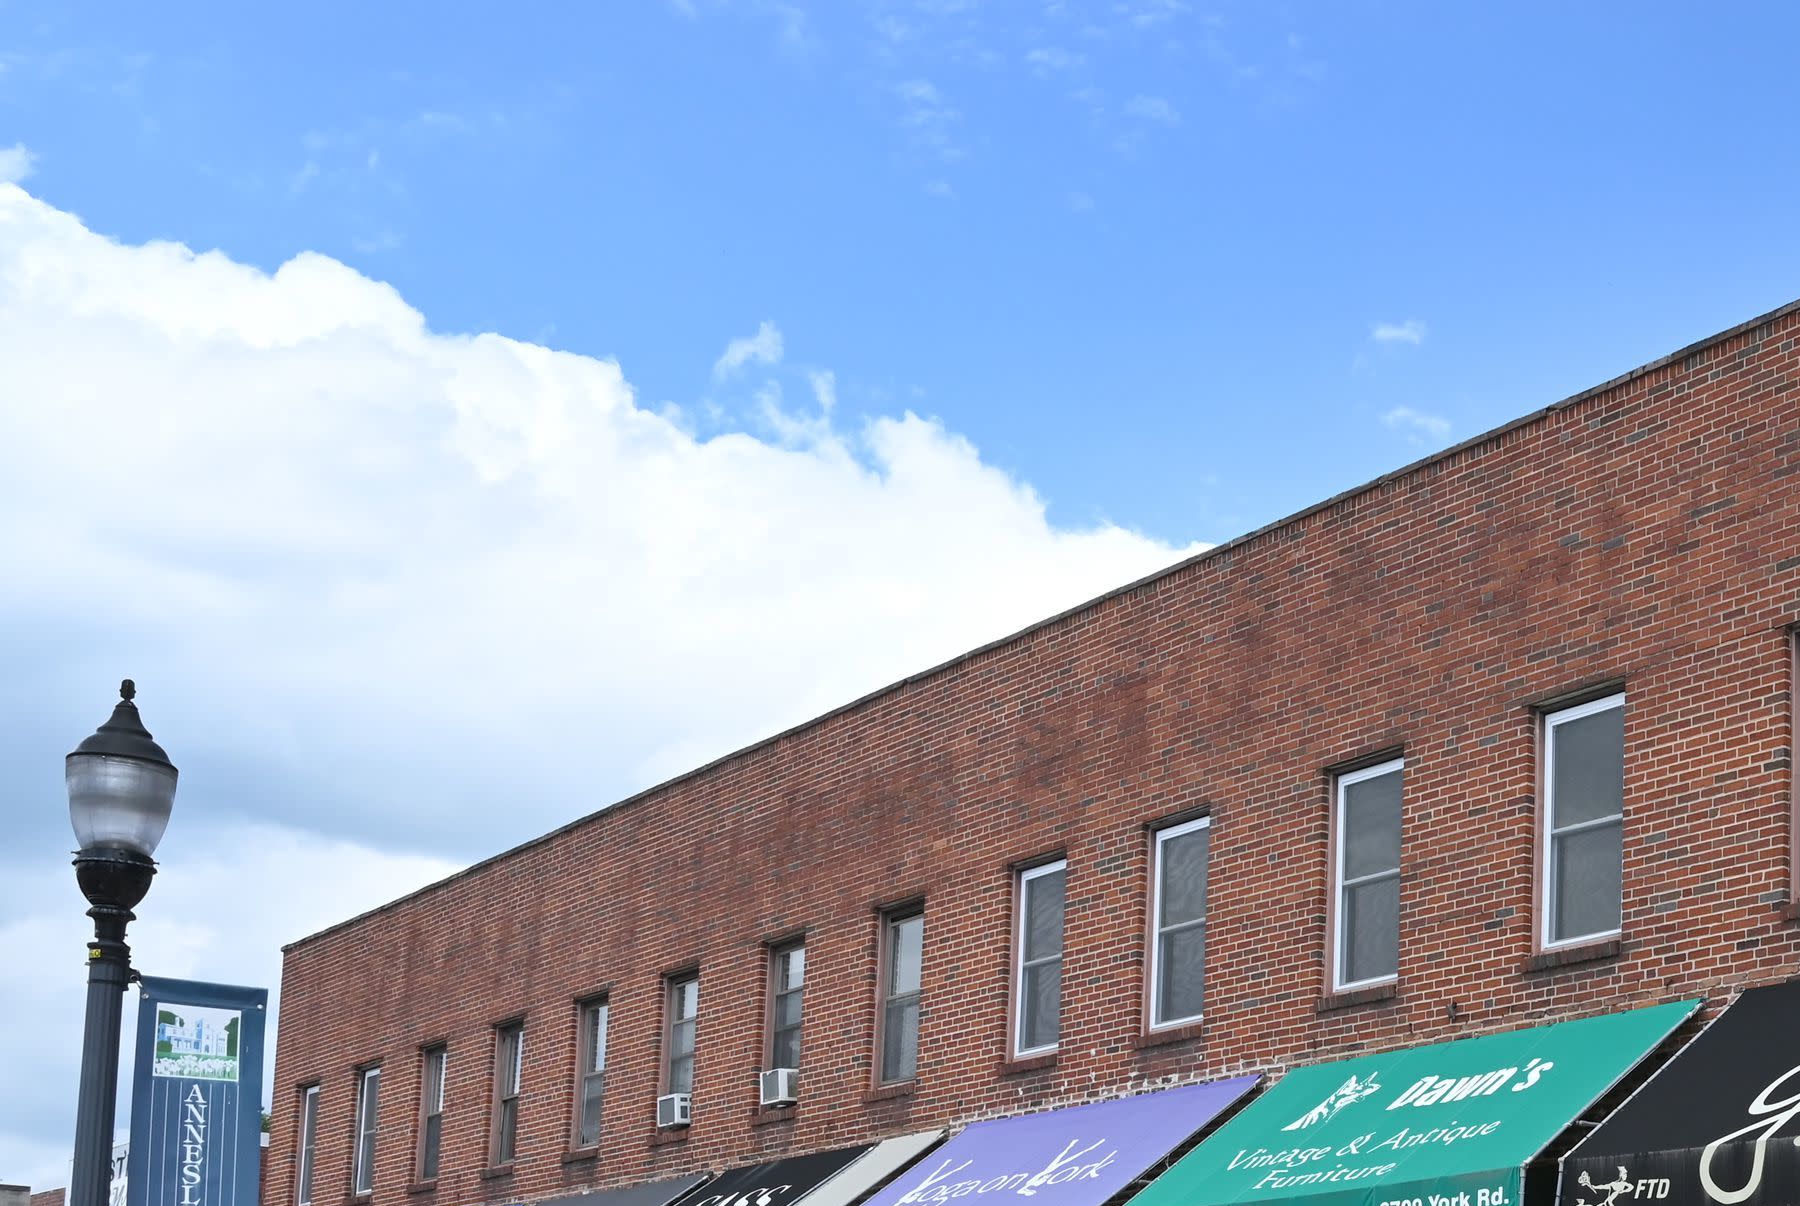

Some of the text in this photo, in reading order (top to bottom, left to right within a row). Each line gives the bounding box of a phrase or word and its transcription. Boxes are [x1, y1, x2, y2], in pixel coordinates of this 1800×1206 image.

[1386, 1057, 1555, 1112] Dawn's
[1227, 1117, 1503, 1173] Vintage & Antique
[1252, 1162, 1400, 1191] Furniture
[1634, 1177, 1671, 1200] FTD
